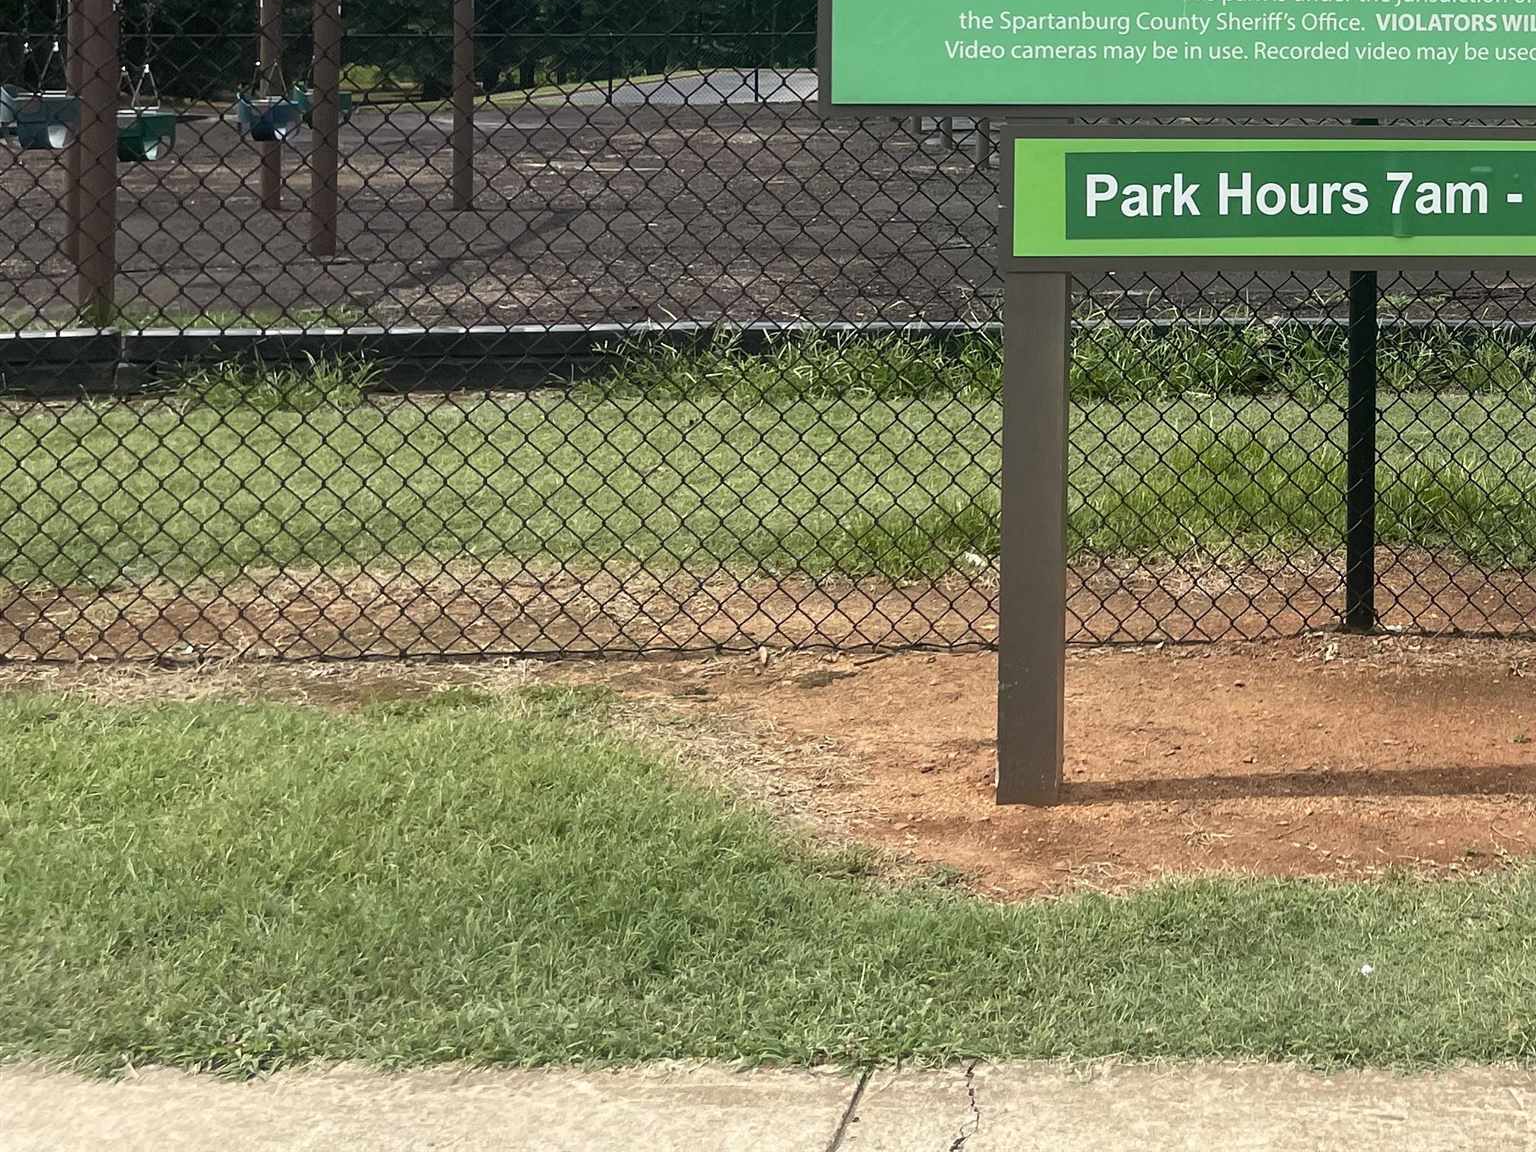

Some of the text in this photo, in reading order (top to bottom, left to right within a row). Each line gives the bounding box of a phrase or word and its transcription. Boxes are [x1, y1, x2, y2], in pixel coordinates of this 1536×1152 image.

[958, 10, 994, 30] the
[999, 10, 1131, 35] Spartanburg
[1135, 11, 1211, 36] County
[1301, 11, 1366, 32] Office.
[1375, 12, 1498, 32] VIOLATORS
[944, 39, 1006, 59] Video
[1010, 44, 1098, 60] cameras
[1103, 45, 1148, 65] may
[1152, 40, 1179, 60] be
[1184, 41, 1203, 60] in
[1208, 45, 1249, 60] use.
[1253, 40, 1350, 60] Recorded
[1354, 41, 1412, 61] video
[1416, 46, 1460, 65] may
[1464, 41, 1490, 61] be
[1086, 172, 1201, 218] Park
[1218, 172, 1369, 216] Hours
[1386, 171, 1488, 215] 7am
